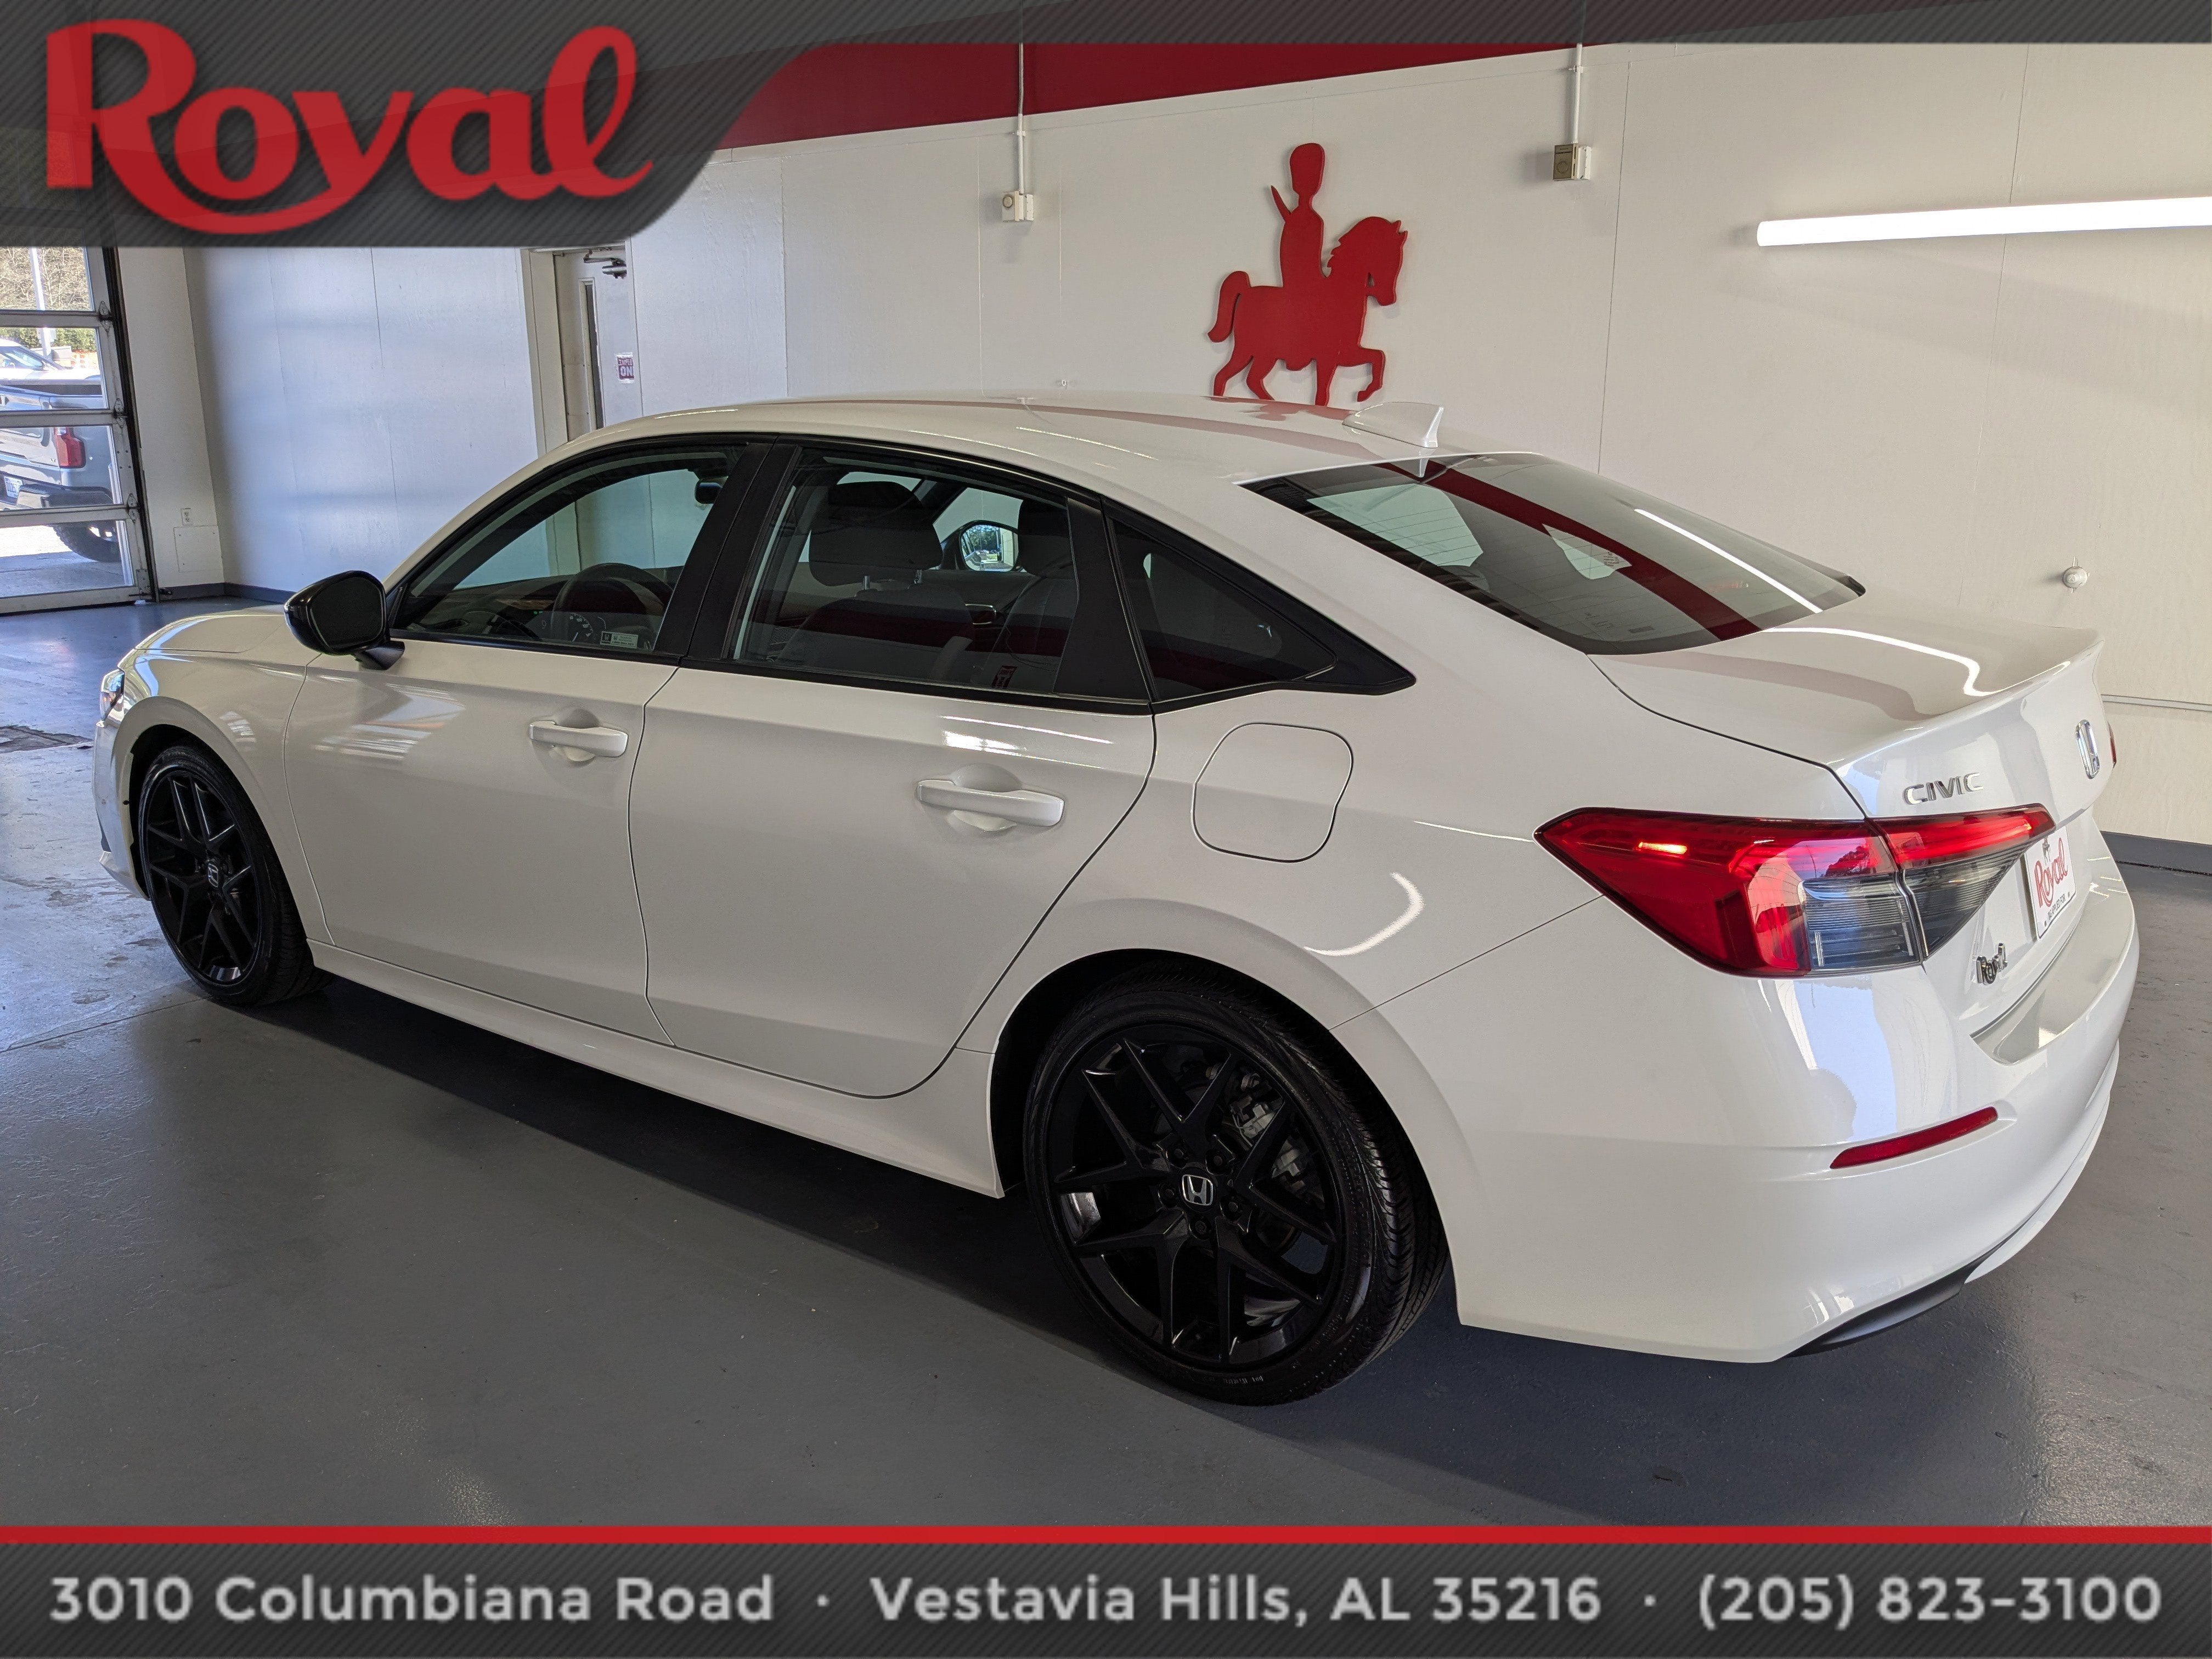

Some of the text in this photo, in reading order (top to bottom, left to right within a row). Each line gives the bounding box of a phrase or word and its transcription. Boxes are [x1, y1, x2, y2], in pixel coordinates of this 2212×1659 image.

[620, 366, 633, 377] ON
[1903, 772, 1984, 805] CIVIC
[2034, 837, 2068, 908] Royal
